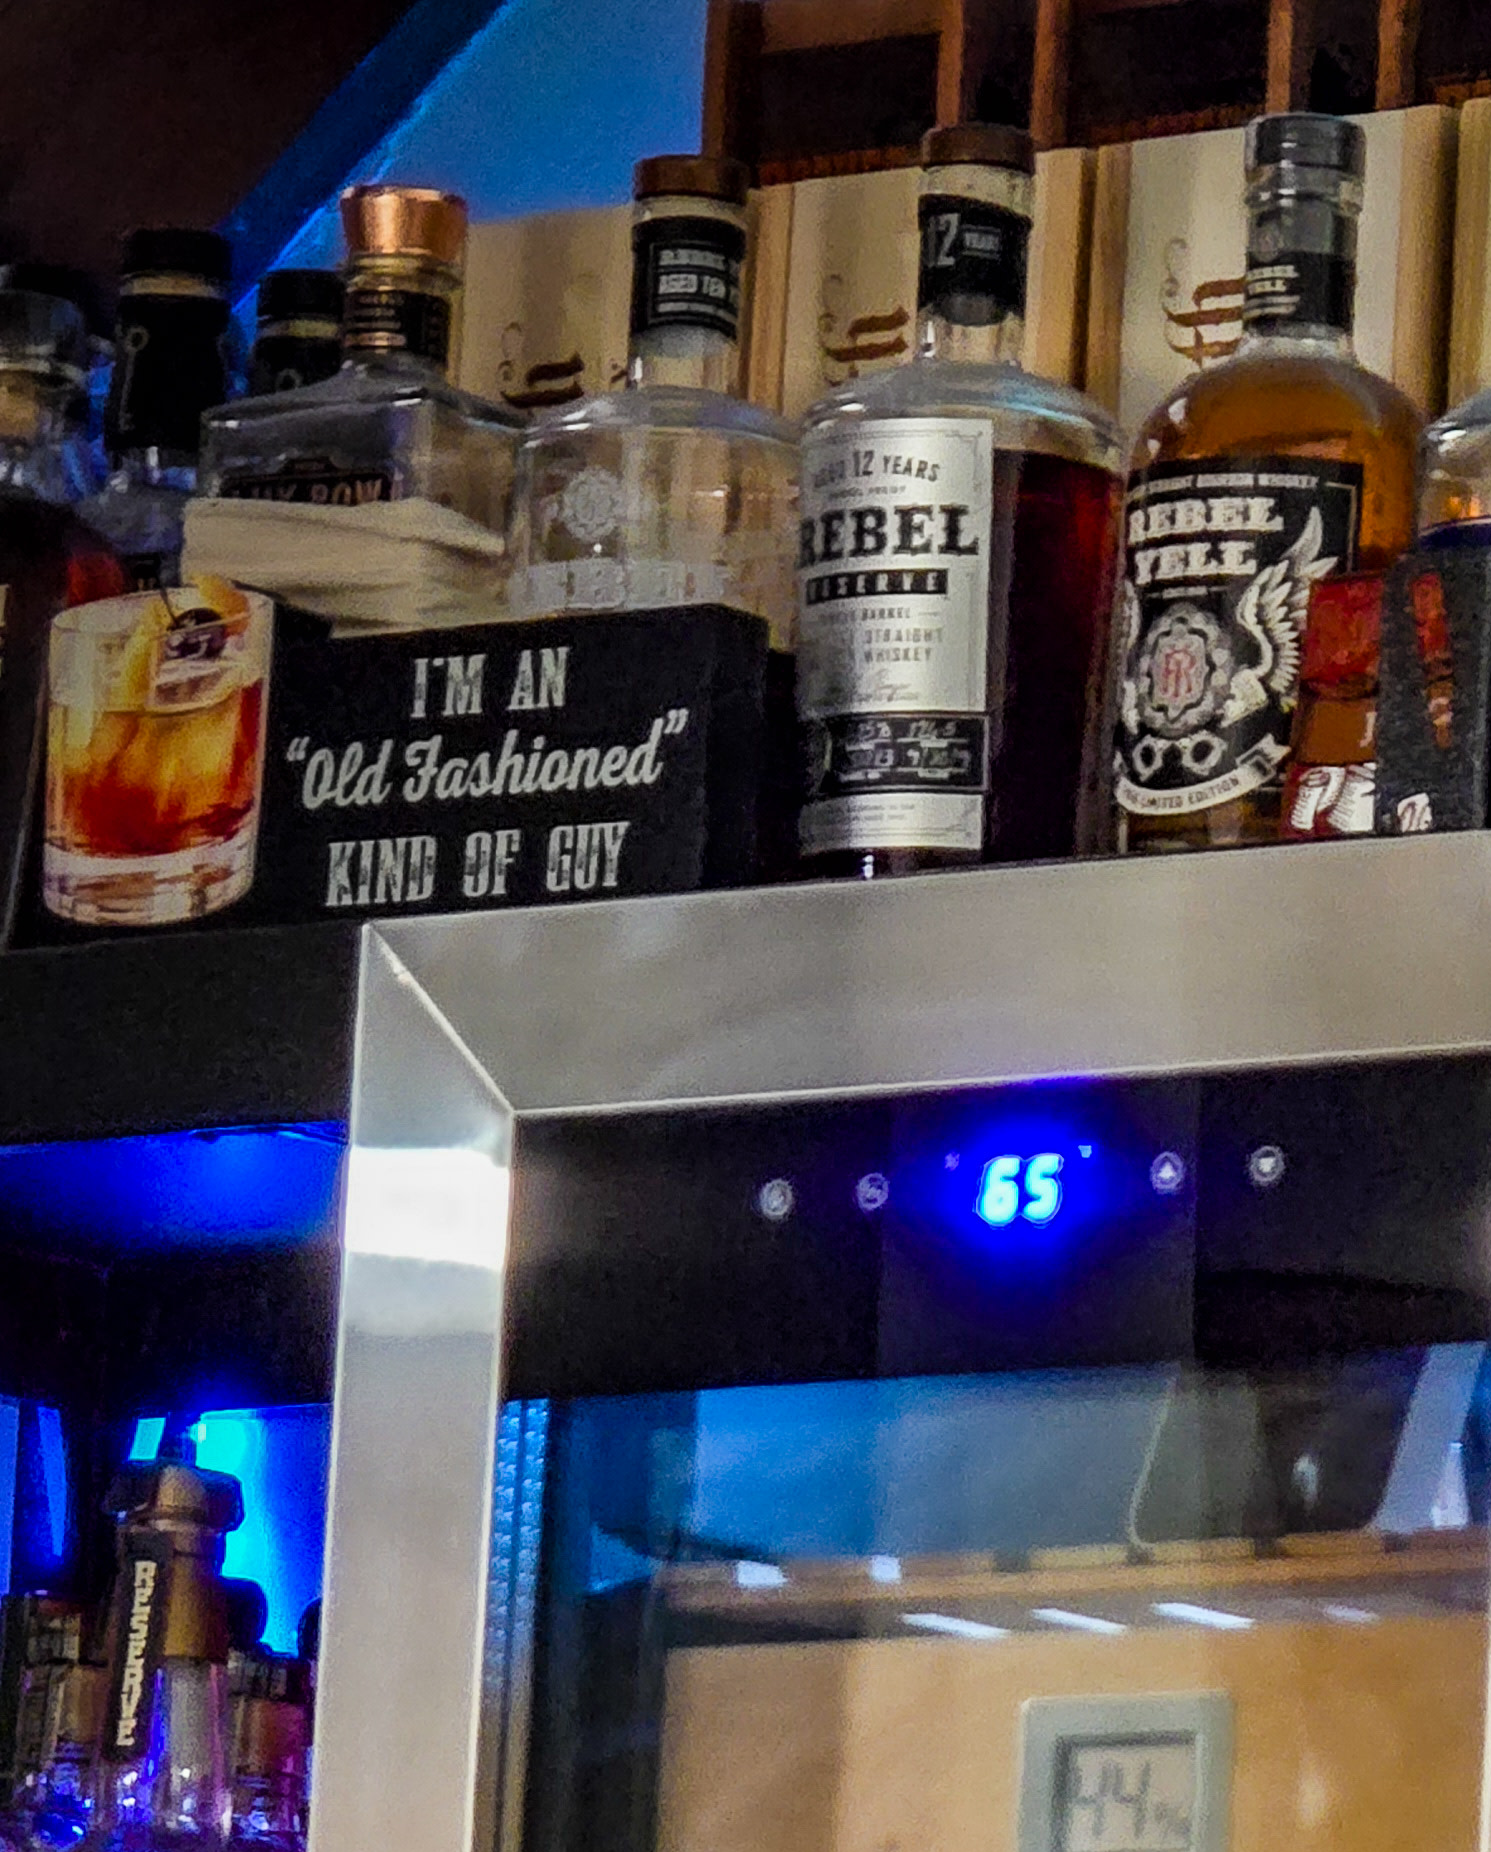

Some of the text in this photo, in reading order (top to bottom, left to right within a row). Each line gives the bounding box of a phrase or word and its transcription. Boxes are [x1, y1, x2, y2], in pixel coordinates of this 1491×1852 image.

[853, 450, 876, 478] 12
[882, 455, 941, 482] YEARS
[797, 504, 980, 569] REBEL
[1128, 496, 1285, 545] REBEL
[1134, 540, 1257, 586] YELL
[409, 646, 571, 719] I'M AN
[325, 820, 631, 907] KIND OF GUY
[976, 1153, 1064, 1228] 65
[115, 1559, 157, 1747] RESERVE
